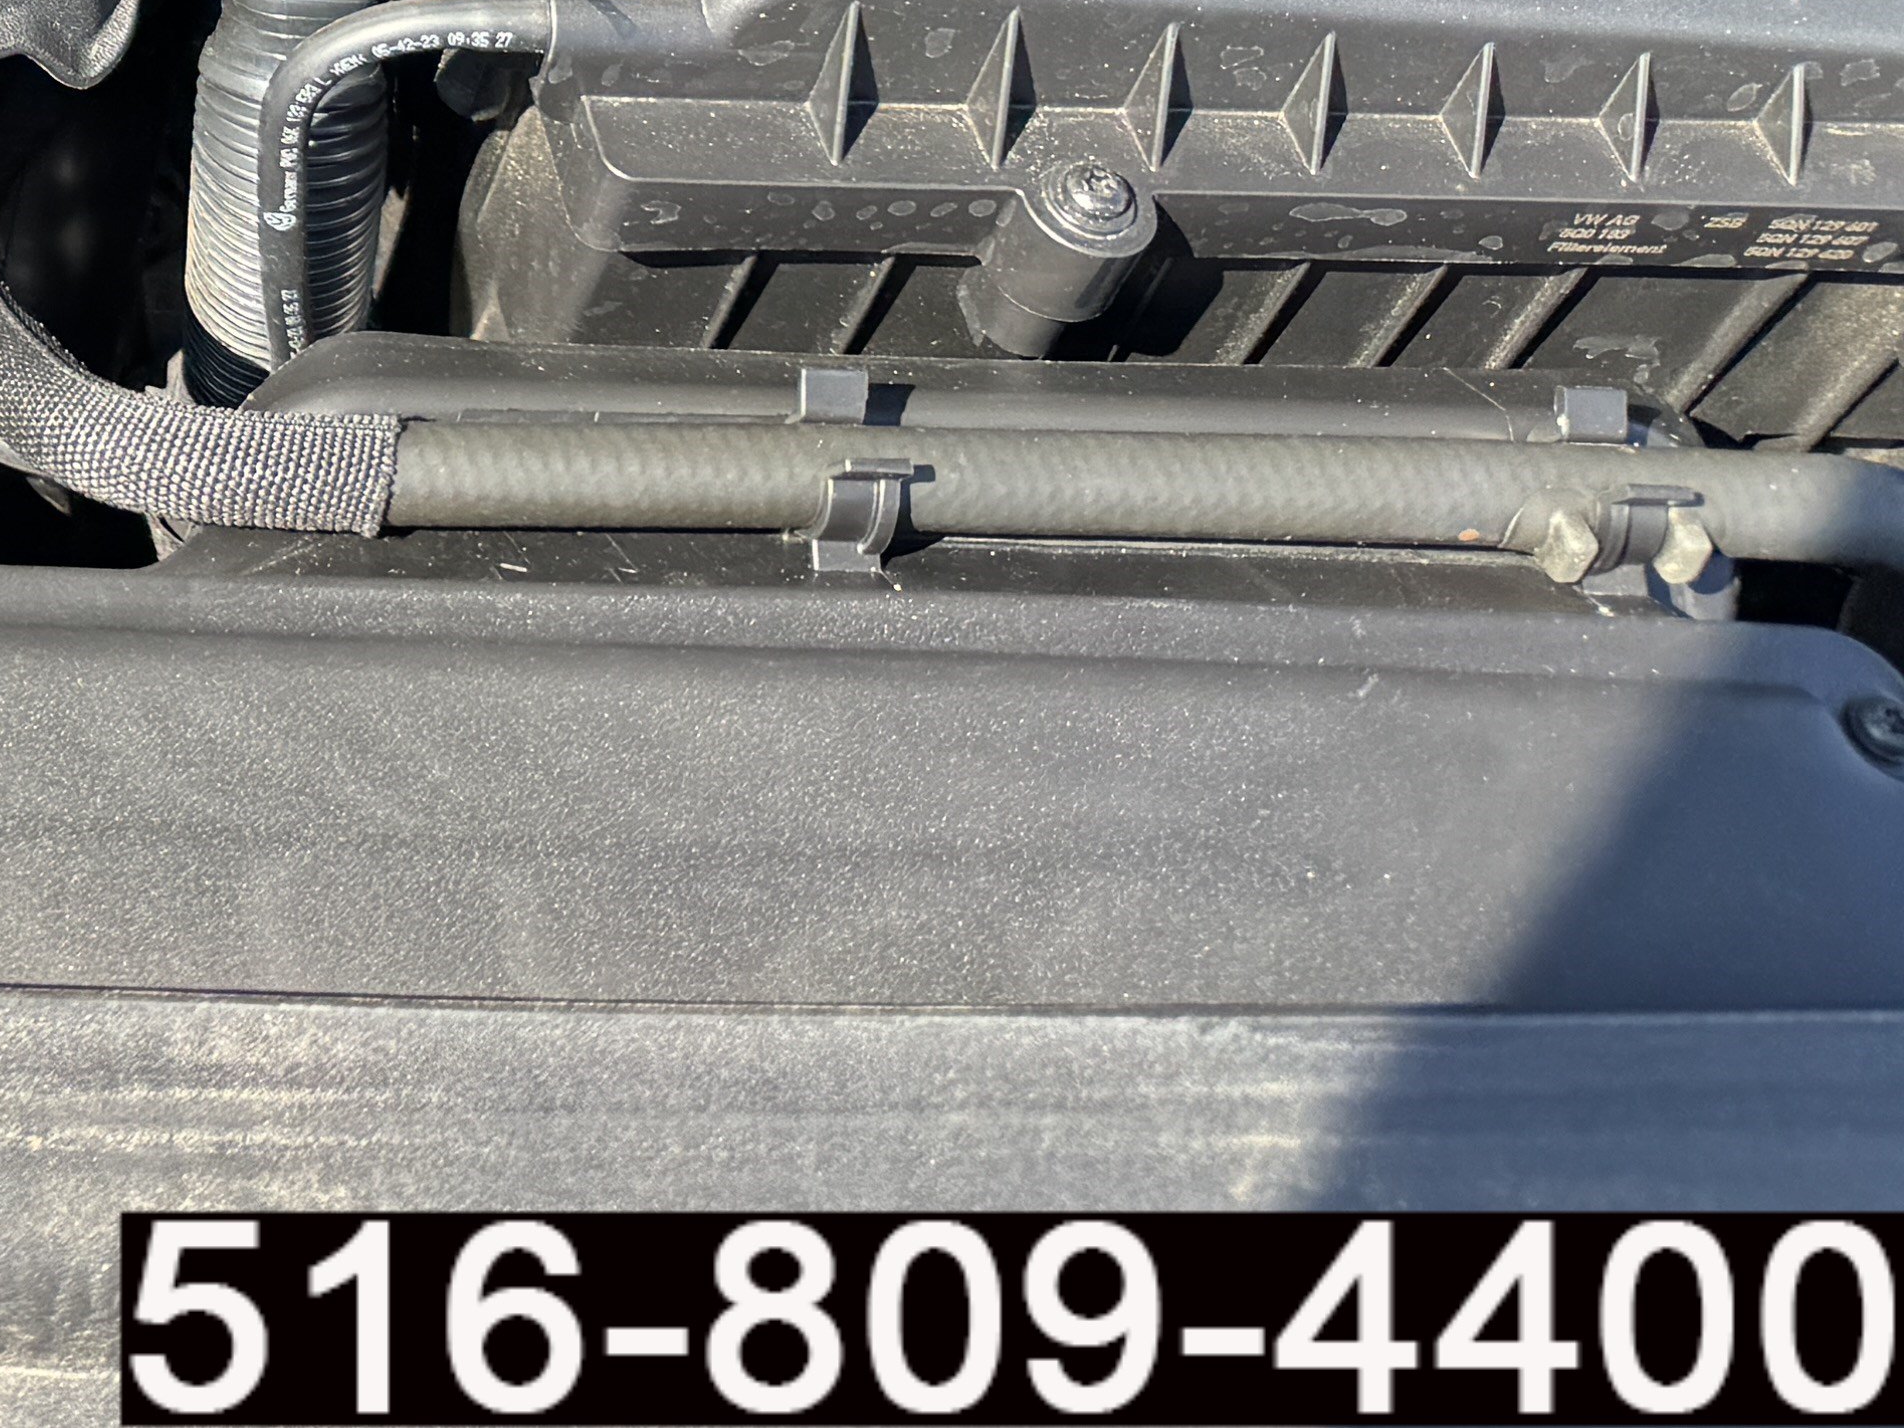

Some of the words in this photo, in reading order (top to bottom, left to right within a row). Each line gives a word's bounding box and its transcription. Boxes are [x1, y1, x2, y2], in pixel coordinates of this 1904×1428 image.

[495, 31, 513, 48] 27
[1574, 213, 1608, 227] VW
[1605, 214, 1640, 227] AG
